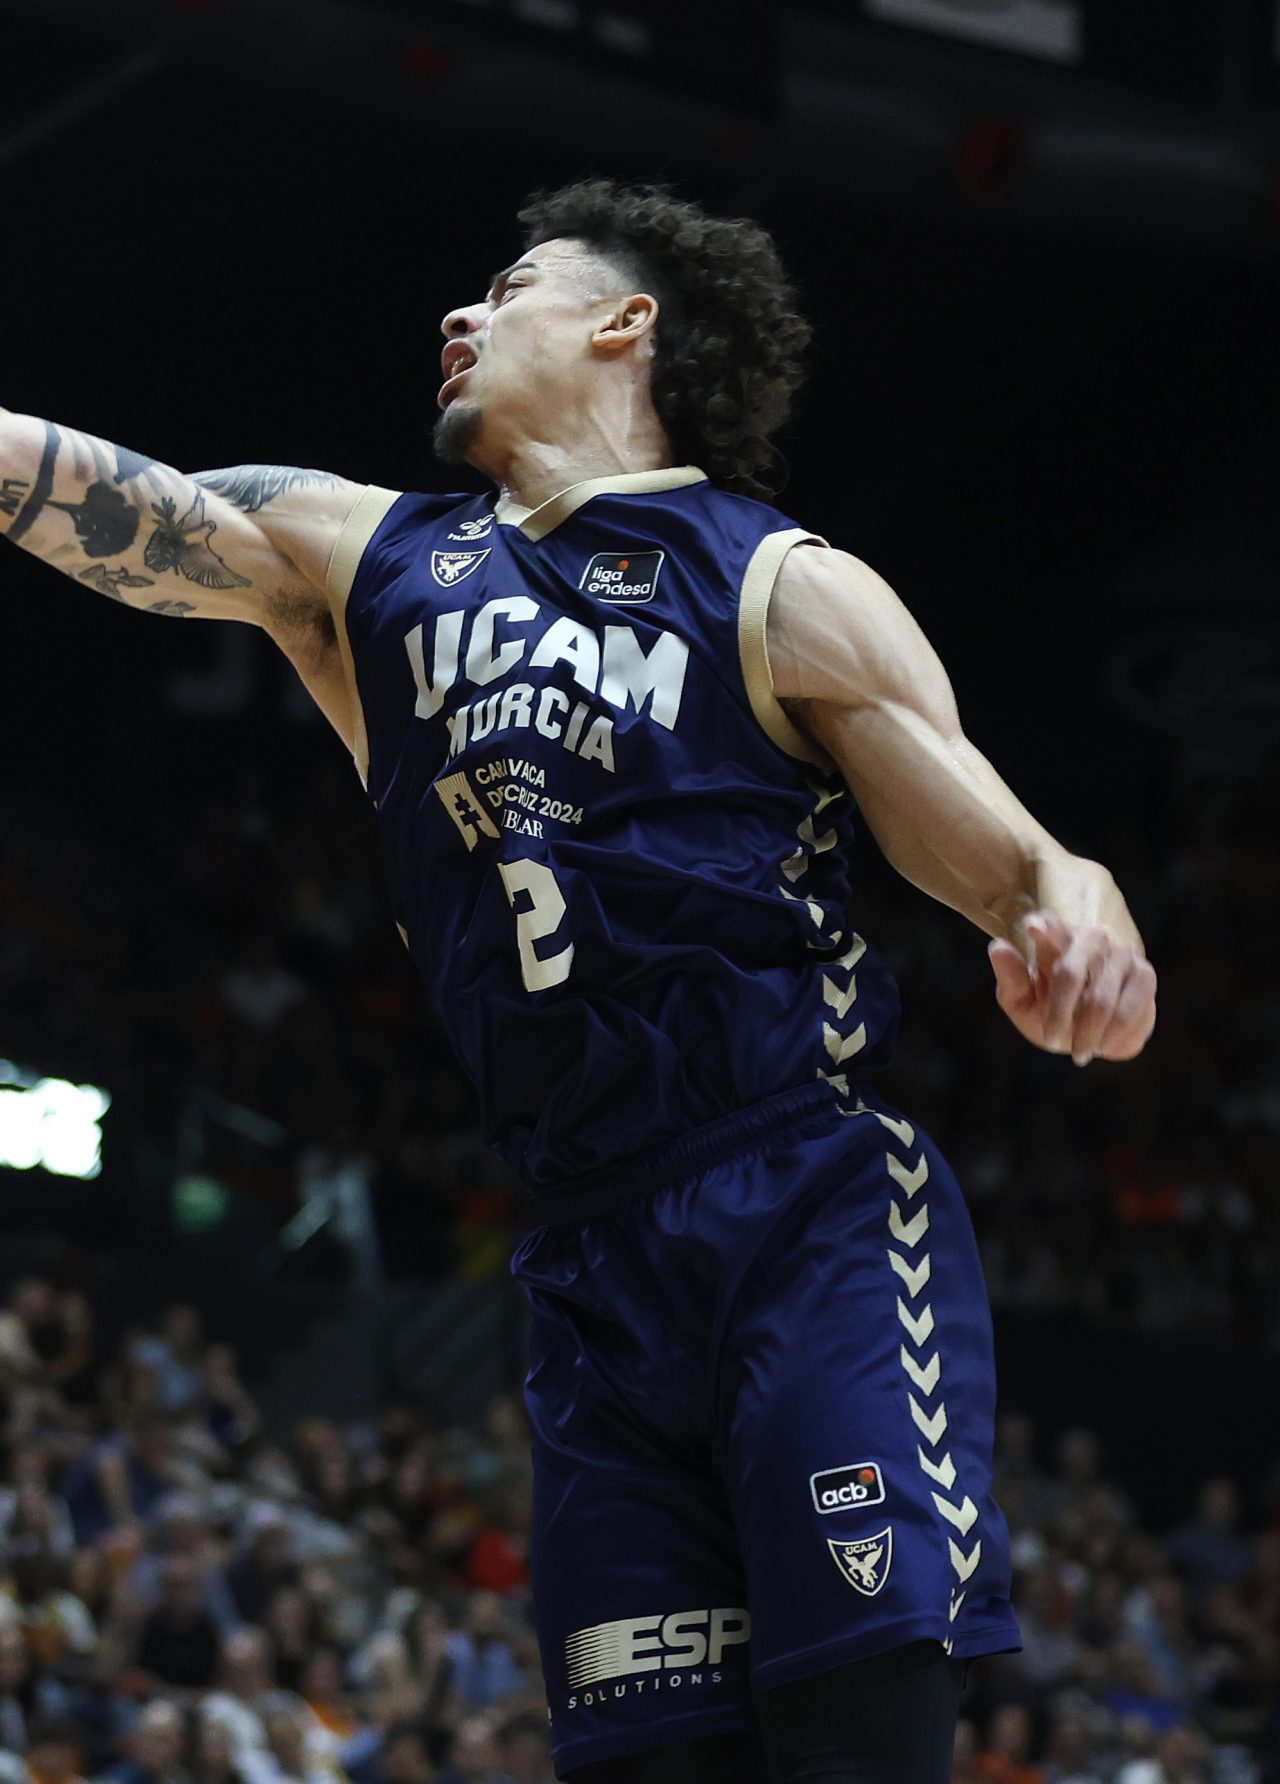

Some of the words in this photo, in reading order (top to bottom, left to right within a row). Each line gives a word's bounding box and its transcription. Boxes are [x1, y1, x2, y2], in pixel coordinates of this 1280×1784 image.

[588, 582, 651, 596] endesa
[591, 566, 624, 583] liga
[404, 595, 690, 731] UCAM
[445, 682, 616, 774] MURCIA
[538, 797, 584, 825] 2024
[497, 857, 575, 993] 2
[822, 1482, 868, 1506] acb
[845, 1542, 878, 1556] UCAM
[566, 1607, 752, 1689] ESP
[568, 1671, 723, 1710] SOLUTIONS
